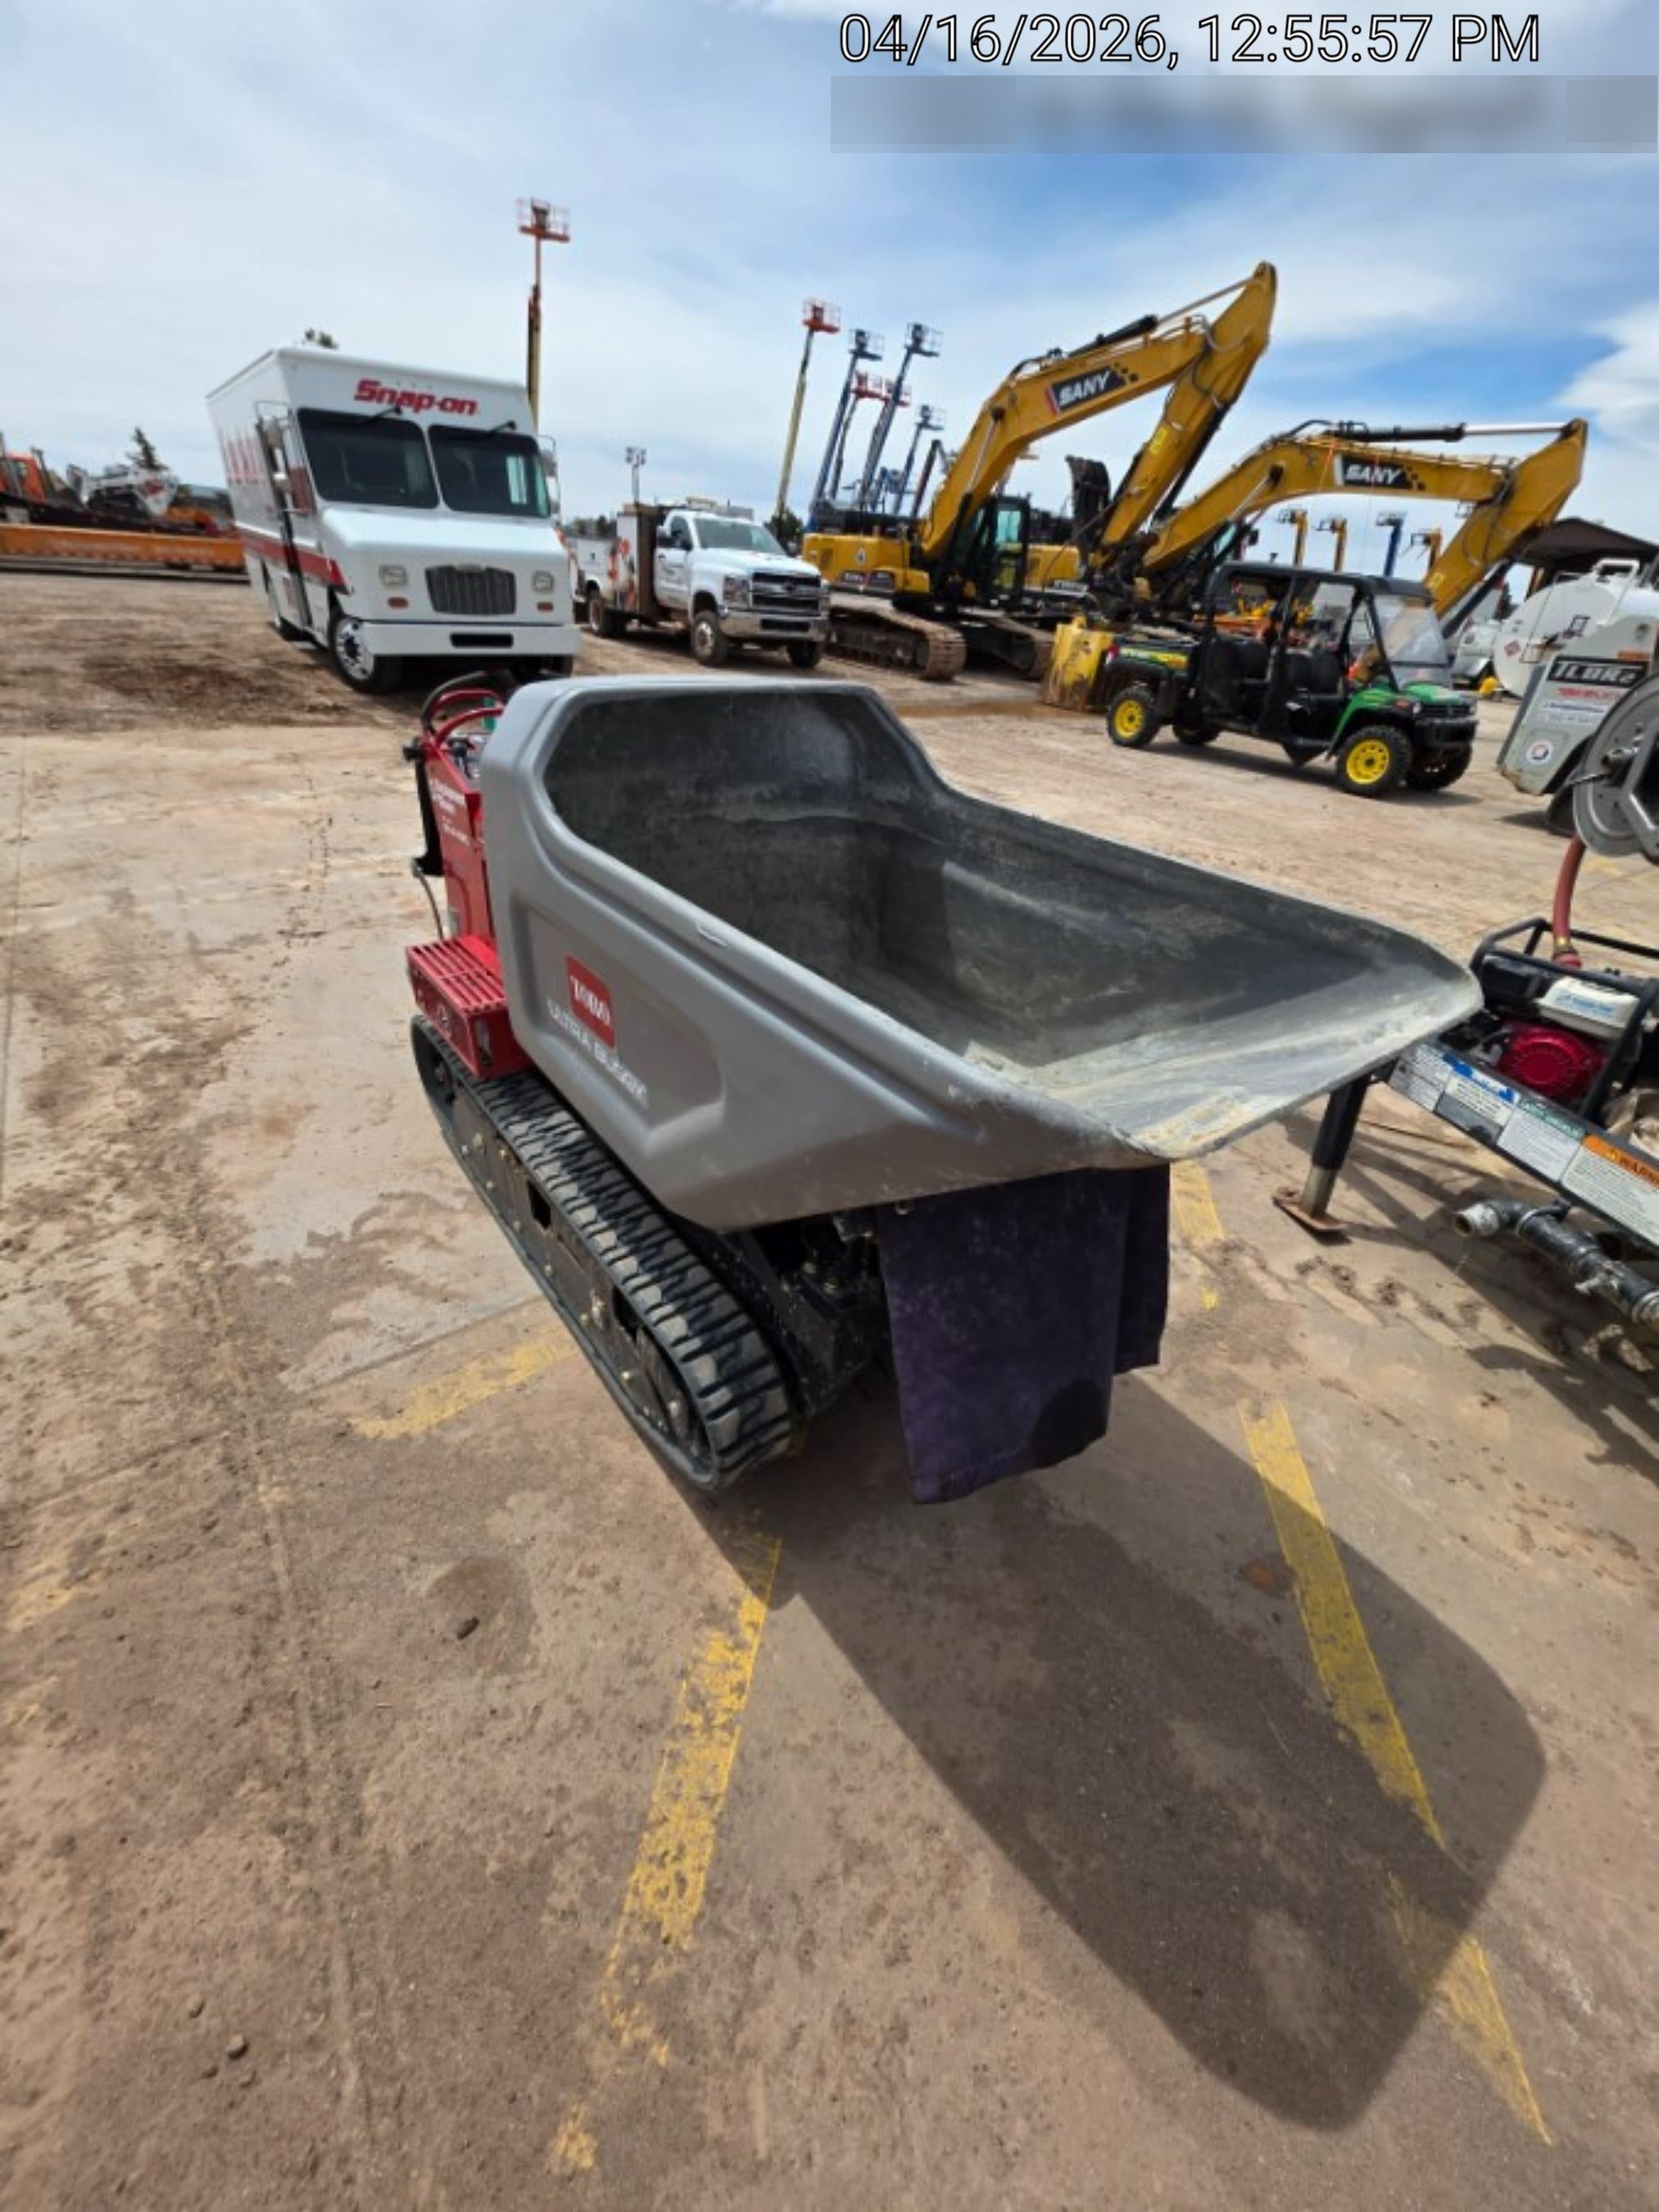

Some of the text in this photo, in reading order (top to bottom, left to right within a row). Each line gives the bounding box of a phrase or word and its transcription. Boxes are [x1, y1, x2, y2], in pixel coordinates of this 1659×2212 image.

[354, 379, 478, 415] Snap-on
[1059, 369, 1111, 407] SANY
[1345, 463, 1403, 485] SANY
